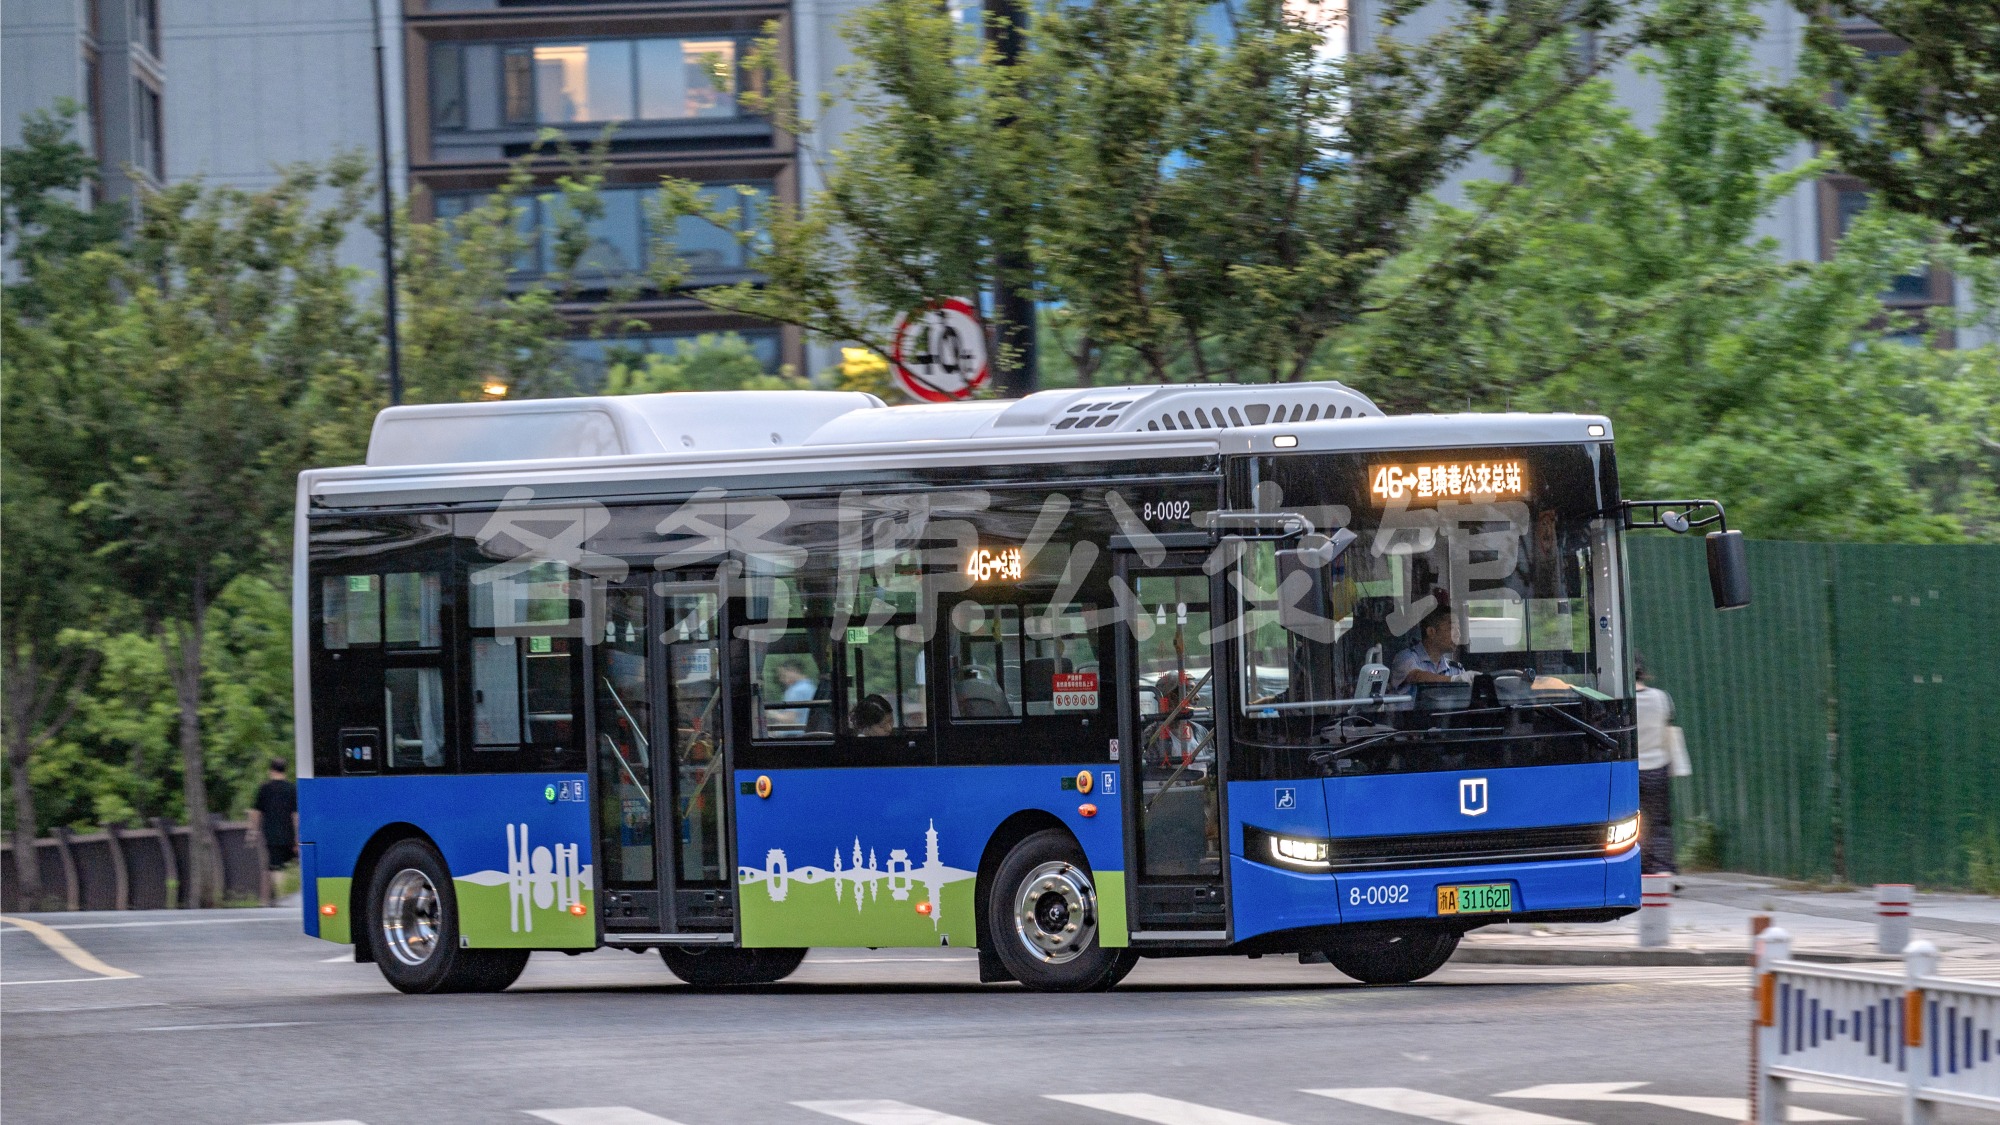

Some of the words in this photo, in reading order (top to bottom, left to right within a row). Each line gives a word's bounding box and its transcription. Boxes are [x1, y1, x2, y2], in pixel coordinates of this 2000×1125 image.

[1373, 466, 1403, 499] 46
[1144, 500, 1190, 521] 8-0092
[967, 550, 991, 581] 46
[1350, 884, 1409, 906] 8-0092
